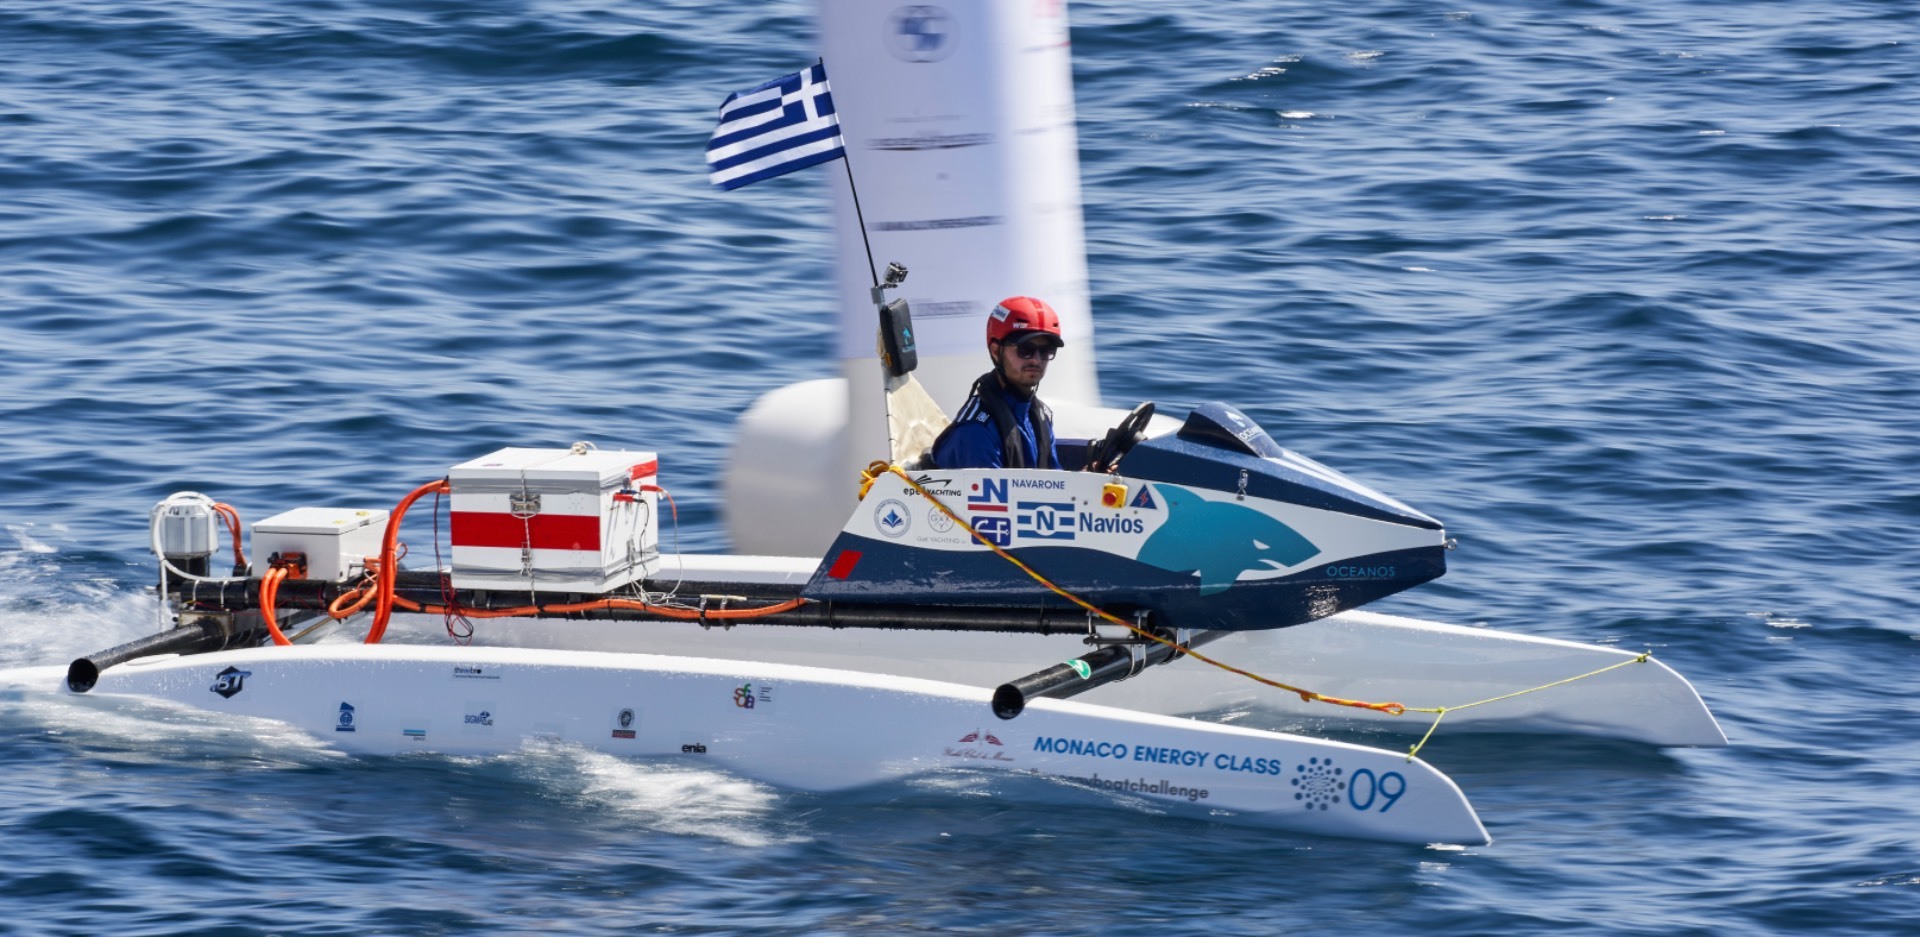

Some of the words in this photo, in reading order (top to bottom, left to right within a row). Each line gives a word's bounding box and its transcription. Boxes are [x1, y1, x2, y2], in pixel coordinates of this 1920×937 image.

[1012, 479, 1065, 490] NAVARONE
[1079, 512, 1144, 534] Navios
[1326, 566, 1395, 577] OCEANOS
[1033, 736, 1128, 759] MONACO
[1134, 745, 1209, 767] ENERGY
[1214, 753, 1281, 776] CLASS
[1348, 768, 1407, 813] 09
